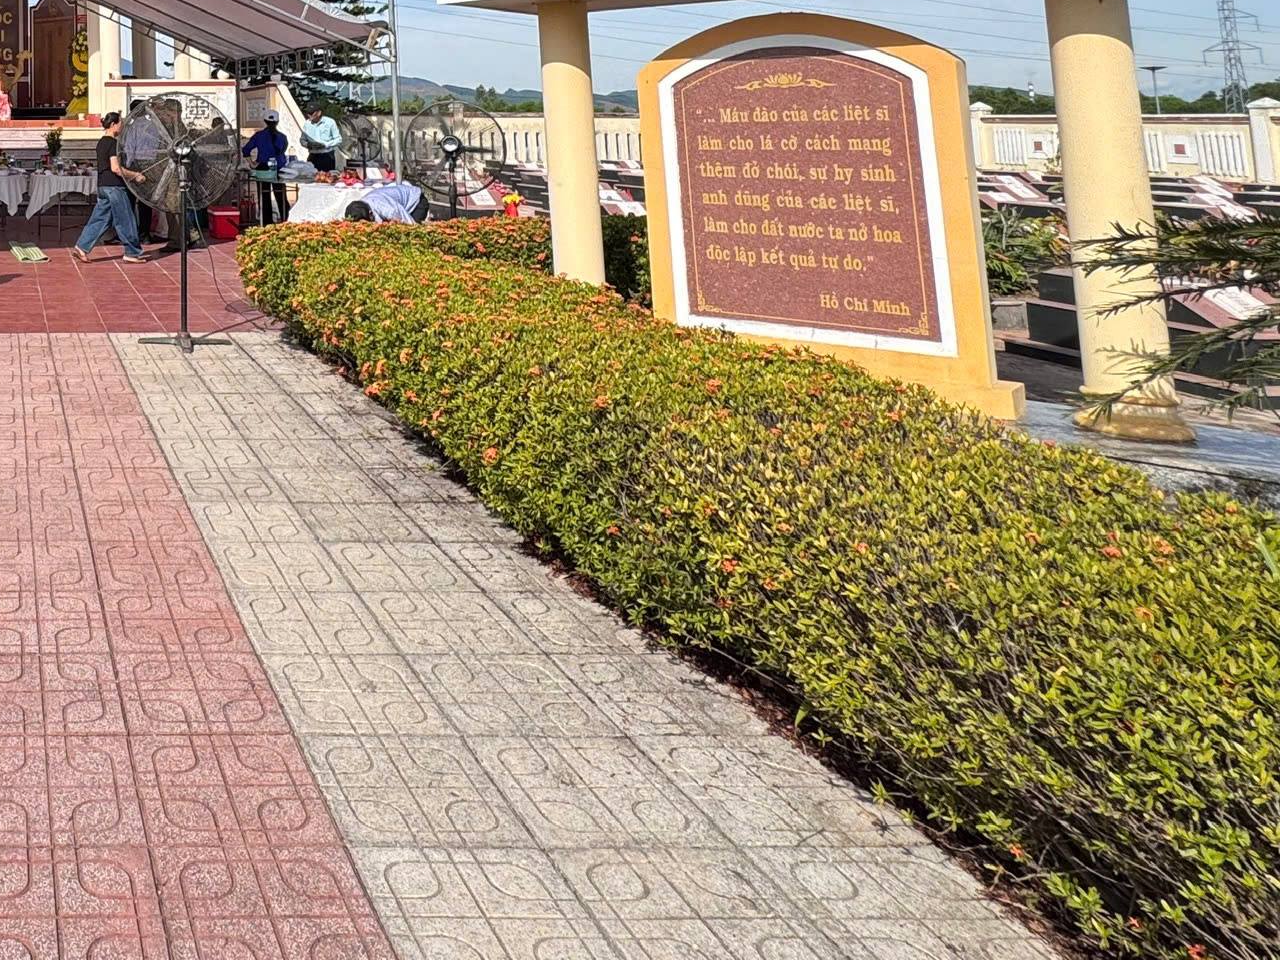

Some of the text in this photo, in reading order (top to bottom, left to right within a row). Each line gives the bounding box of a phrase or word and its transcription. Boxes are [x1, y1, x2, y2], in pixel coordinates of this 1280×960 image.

[720, 108, 748, 123] Máu
[753, 107, 778, 122] đào
[782, 104, 809, 122] của
[813, 105, 839, 122] các
[843, 104, 870, 124] liệt
[876, 106, 890, 121] sĩ
[697, 135, 892, 156] làm cho lá cờ cách mạng
[699, 162, 736, 179] thêm
[743, 161, 759, 178] đỏ
[809, 165, 828, 183] sự
[833, 164, 853, 184] hy
[861, 165, 896, 182] sinh
[702, 191, 728, 205] anh
[734, 191, 770, 211] dũng
[777, 191, 803, 208] của
[810, 194, 836, 209] các
[844, 194, 872, 214] liệt
[703, 217, 902, 244] làm cho đất nước ta nở hoa
[706, 244, 730, 261] độc
[735, 246, 756, 265] lập
[761, 245, 785, 265] kết
[790, 250, 816, 270] quả
[822, 253, 839, 273] tự
[819, 291, 839, 309] Hồ
[873, 300, 911, 316] Minh
